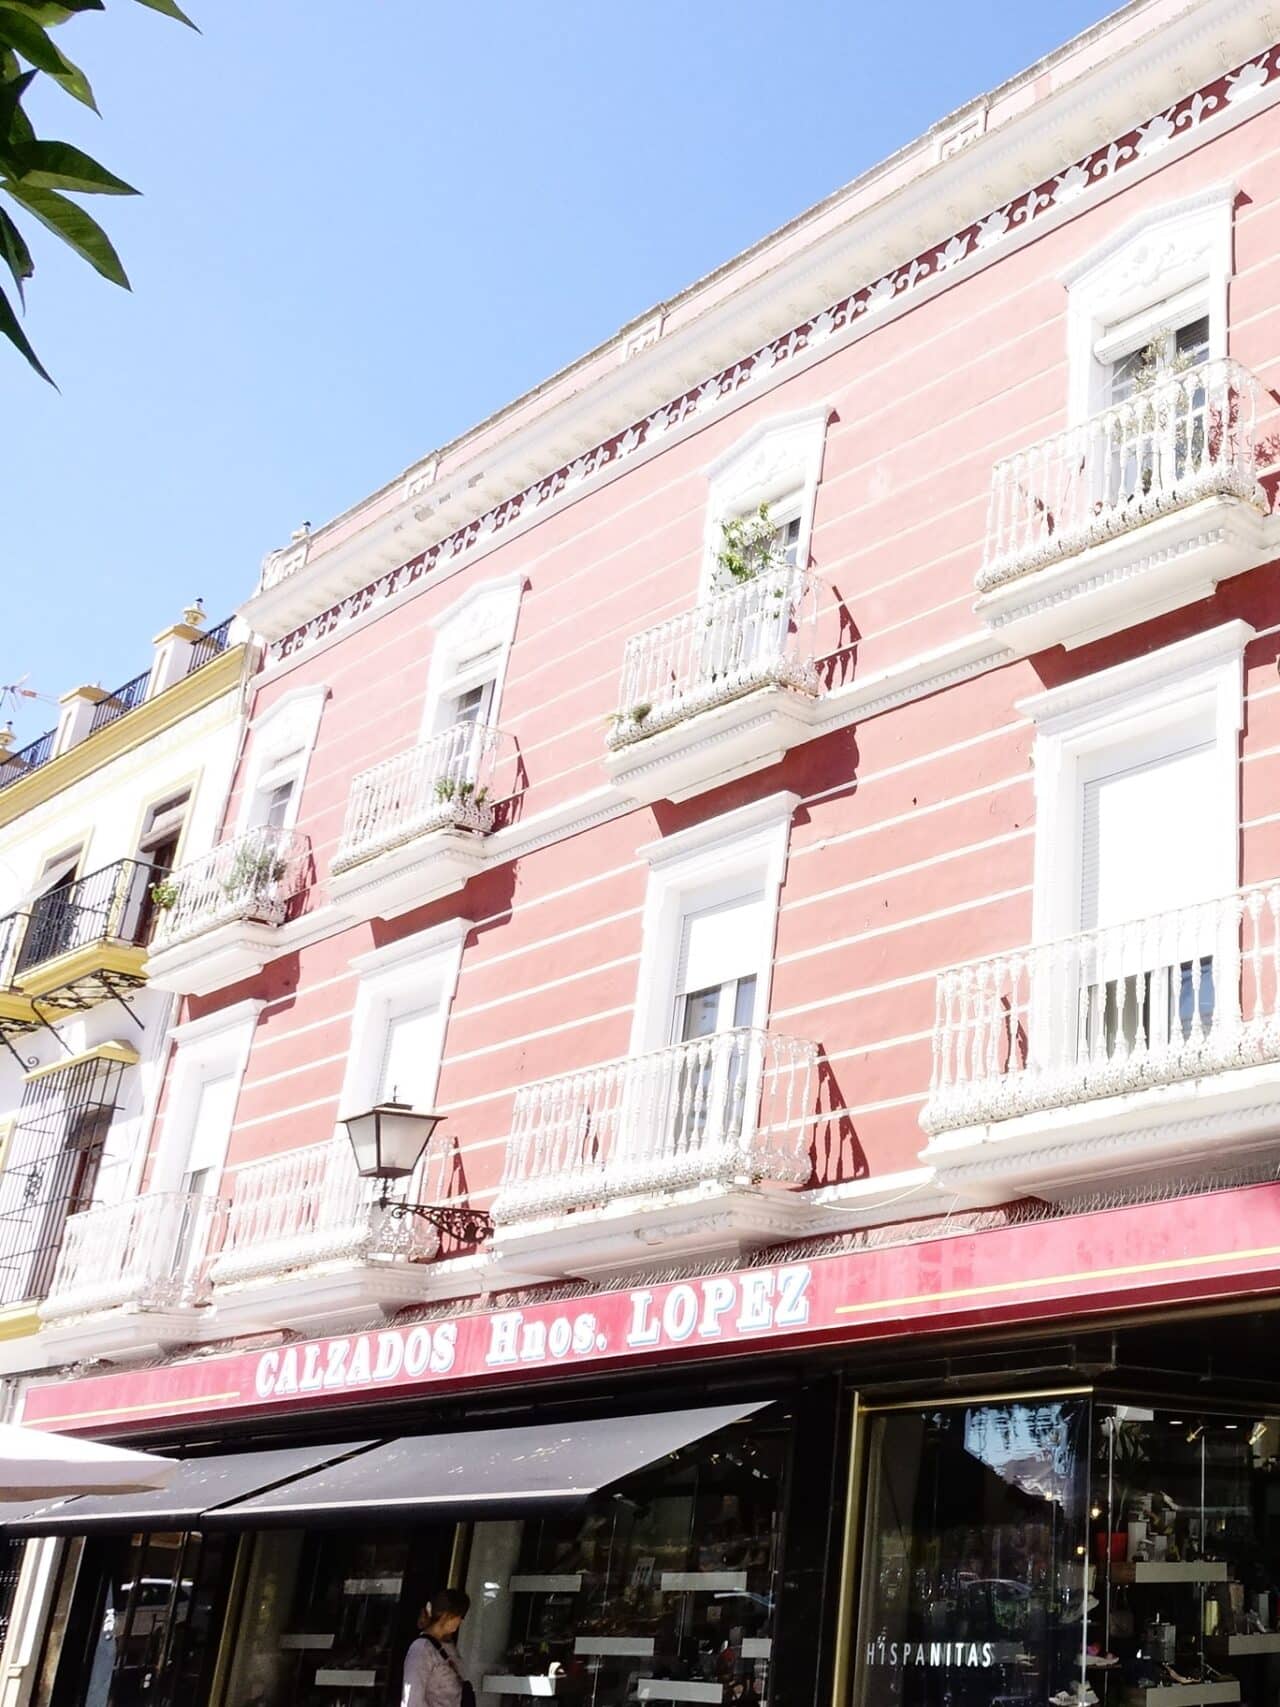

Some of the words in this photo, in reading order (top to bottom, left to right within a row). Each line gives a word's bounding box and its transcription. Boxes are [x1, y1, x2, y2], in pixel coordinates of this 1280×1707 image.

[255, 1322, 458, 1399] CALZADOS
[485, 1309, 608, 1367] Hnos.
[627, 1264, 811, 1348] LOPEZ
[866, 1642, 992, 1668] HISPANITAS
